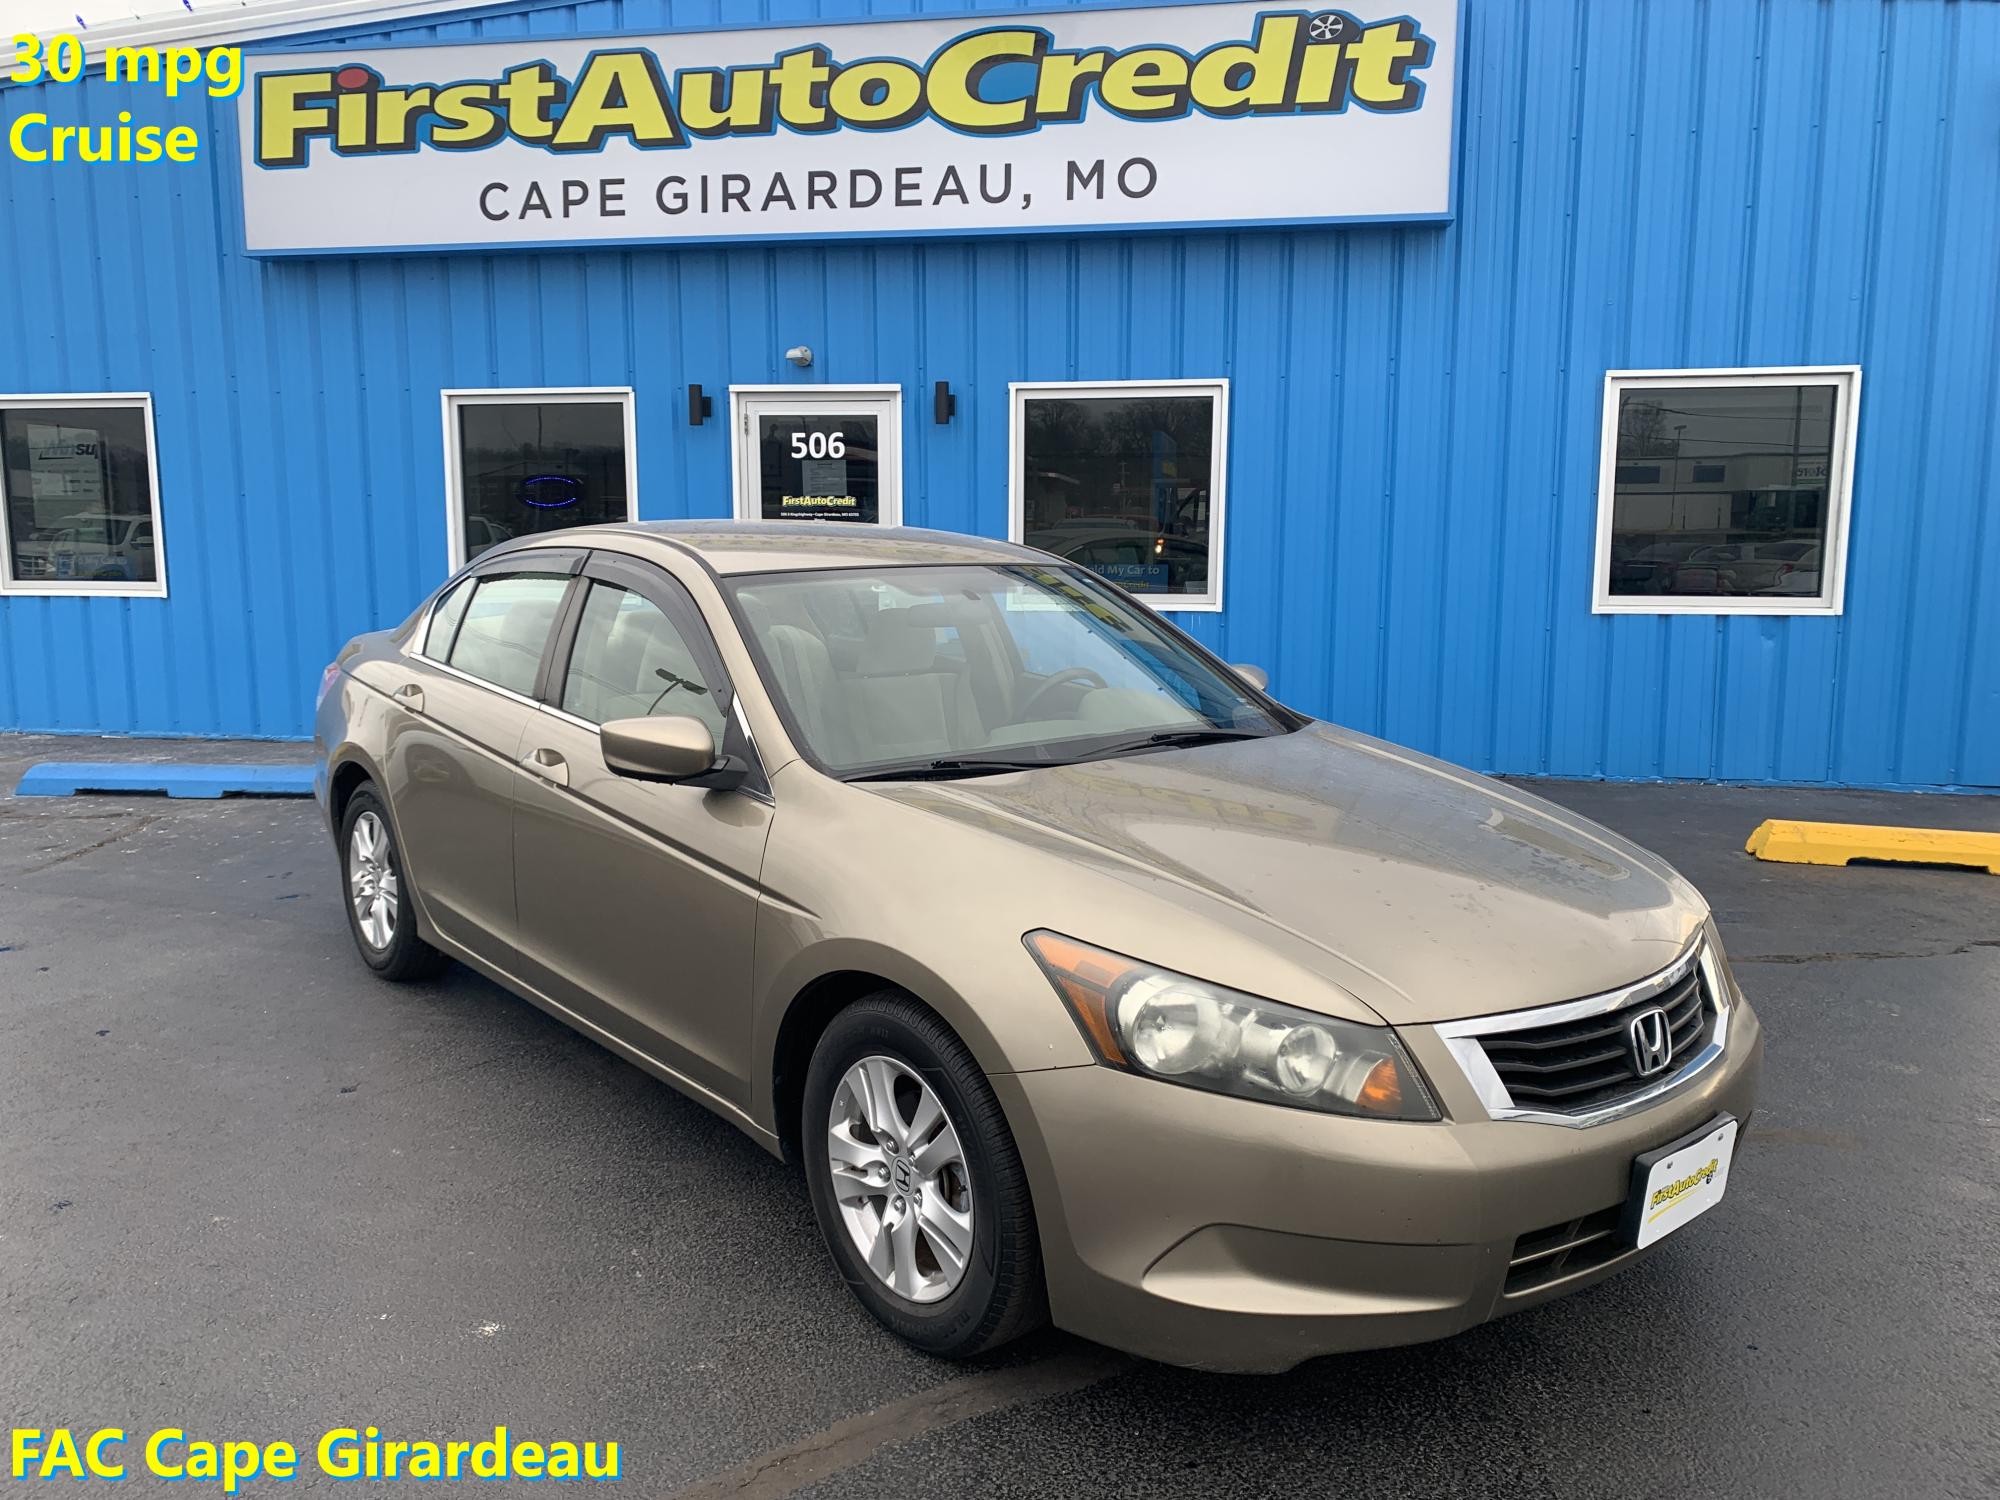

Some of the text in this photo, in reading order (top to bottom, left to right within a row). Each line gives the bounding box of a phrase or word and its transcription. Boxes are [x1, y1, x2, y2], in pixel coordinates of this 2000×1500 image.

[258, 13, 1430, 166] FirstAutoCredit
[480, 156, 1159, 221] CAPE GIRARDEAU, MO
[791, 432, 846, 459] 506
[782, 496, 857, 506] FirstAutoCredit
[1107, 566, 1124, 577] My
[1127, 565, 1146, 575] Car
[1148, 566, 1160, 575] to
